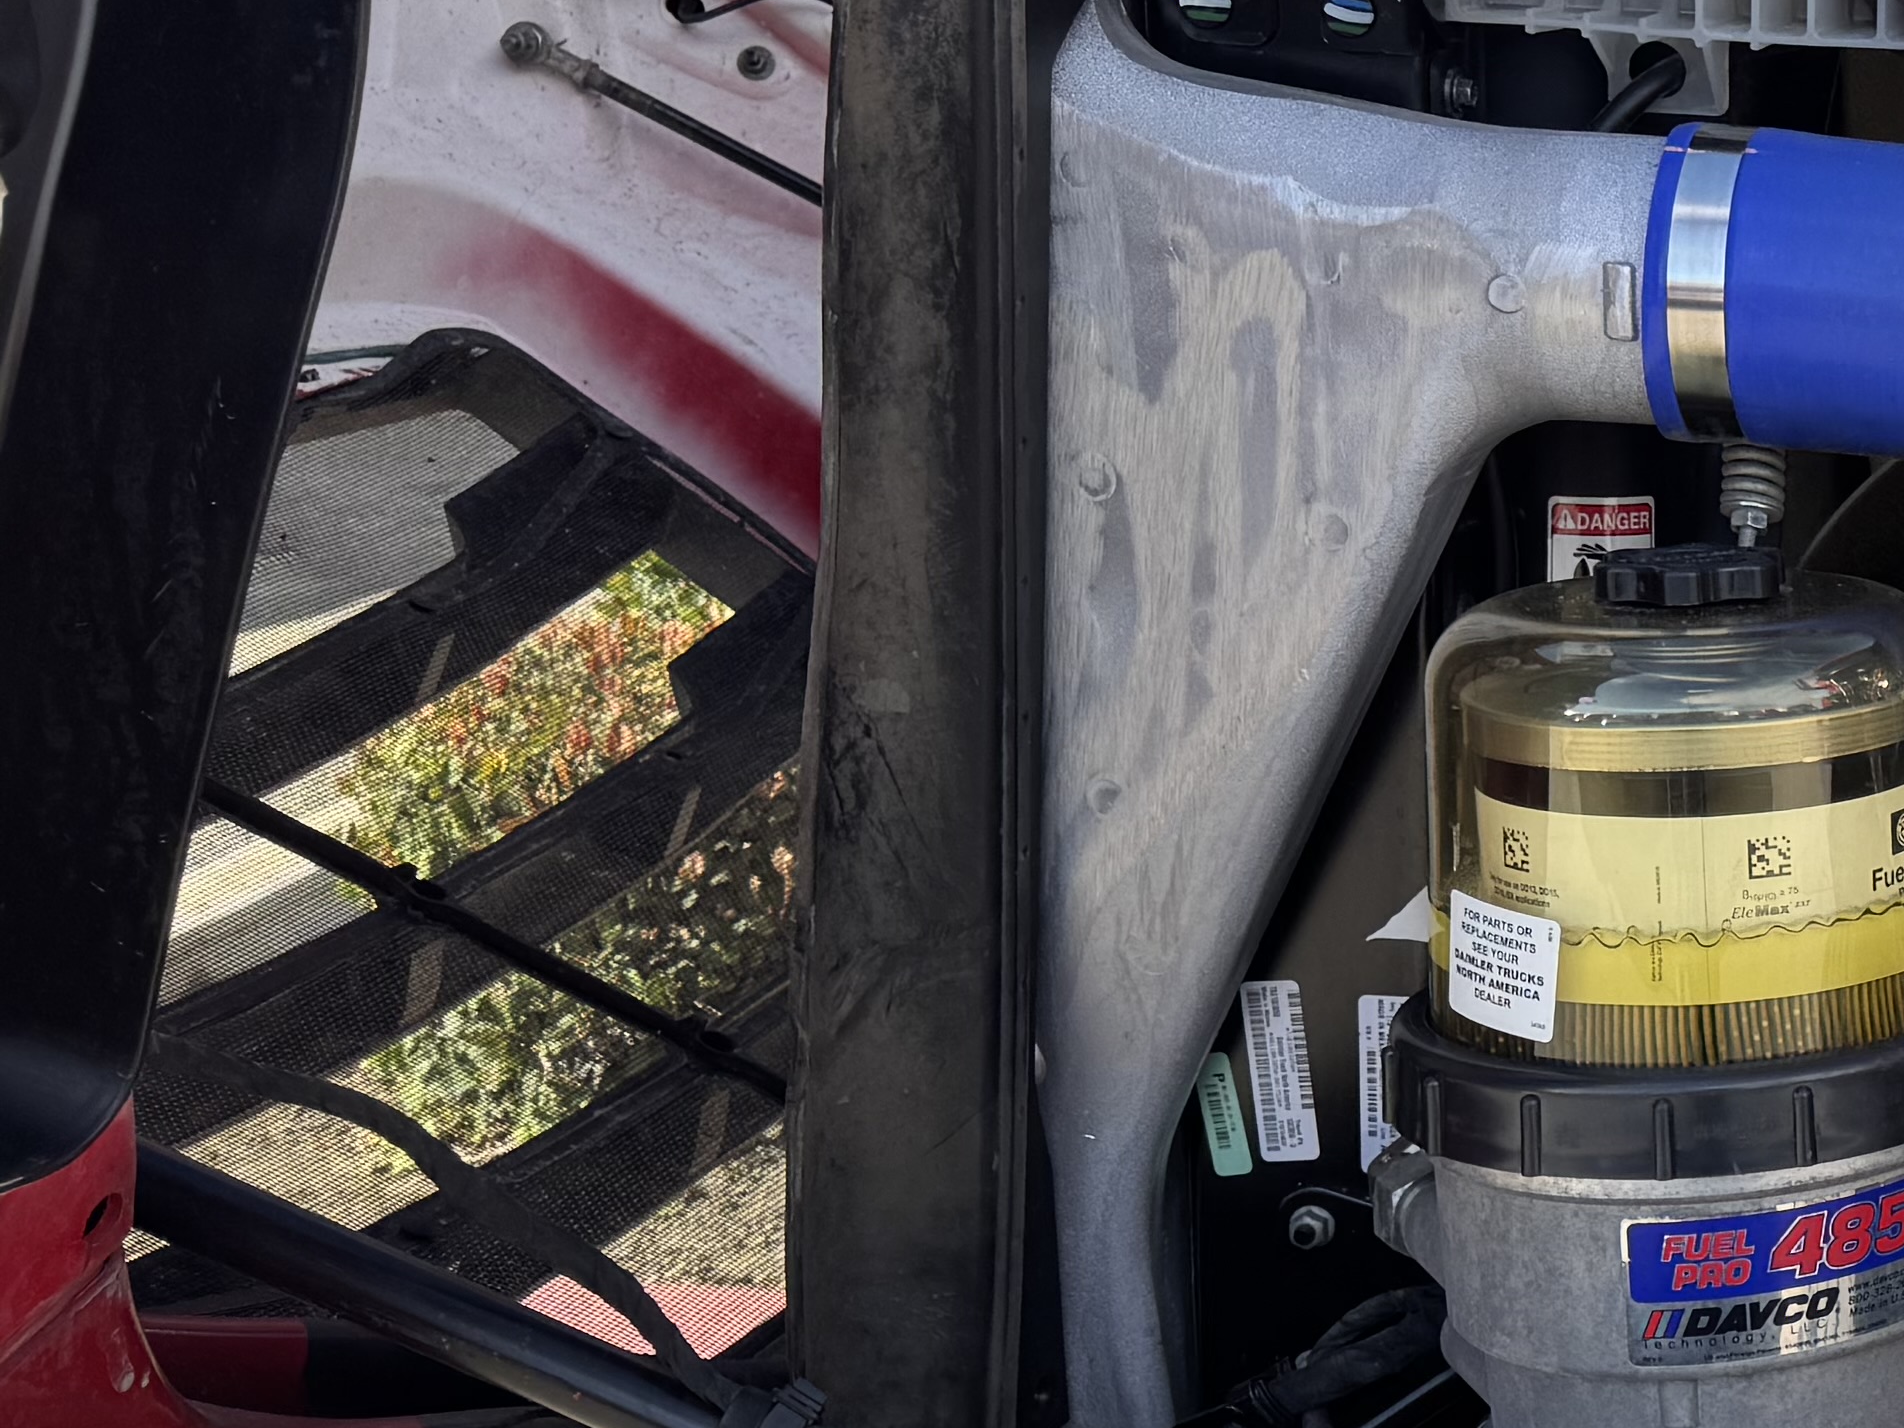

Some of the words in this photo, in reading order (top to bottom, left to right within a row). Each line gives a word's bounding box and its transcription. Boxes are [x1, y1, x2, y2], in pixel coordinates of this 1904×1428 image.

[1577, 511, 1650, 530] DANGER
[1461, 921, 1536, 955] REPLACEMENTS
[1464, 907, 1481, 923] FOR
[1483, 914, 1514, 934] PARTS
[1516, 925, 1533, 938] OR
[1455, 948, 1494, 973] DAIMLER
[1497, 965, 1545, 987] TRUCKS
[1472, 941, 1488, 957] SEE
[1491, 948, 1520, 966] YOUR
[1456, 964, 1486, 985] NORTH
[1488, 977, 1541, 1002] AMERICA
[1474, 987, 1512, 1010] DEALER
[1661, 1228, 1756, 1263] FUEL
[1671, 1259, 1752, 1291] PRO
[1682, 1286, 1840, 1338] DAVCO
[1848, 1301, 1875, 1317] Made
[1876, 1298, 1887, 1311] in
